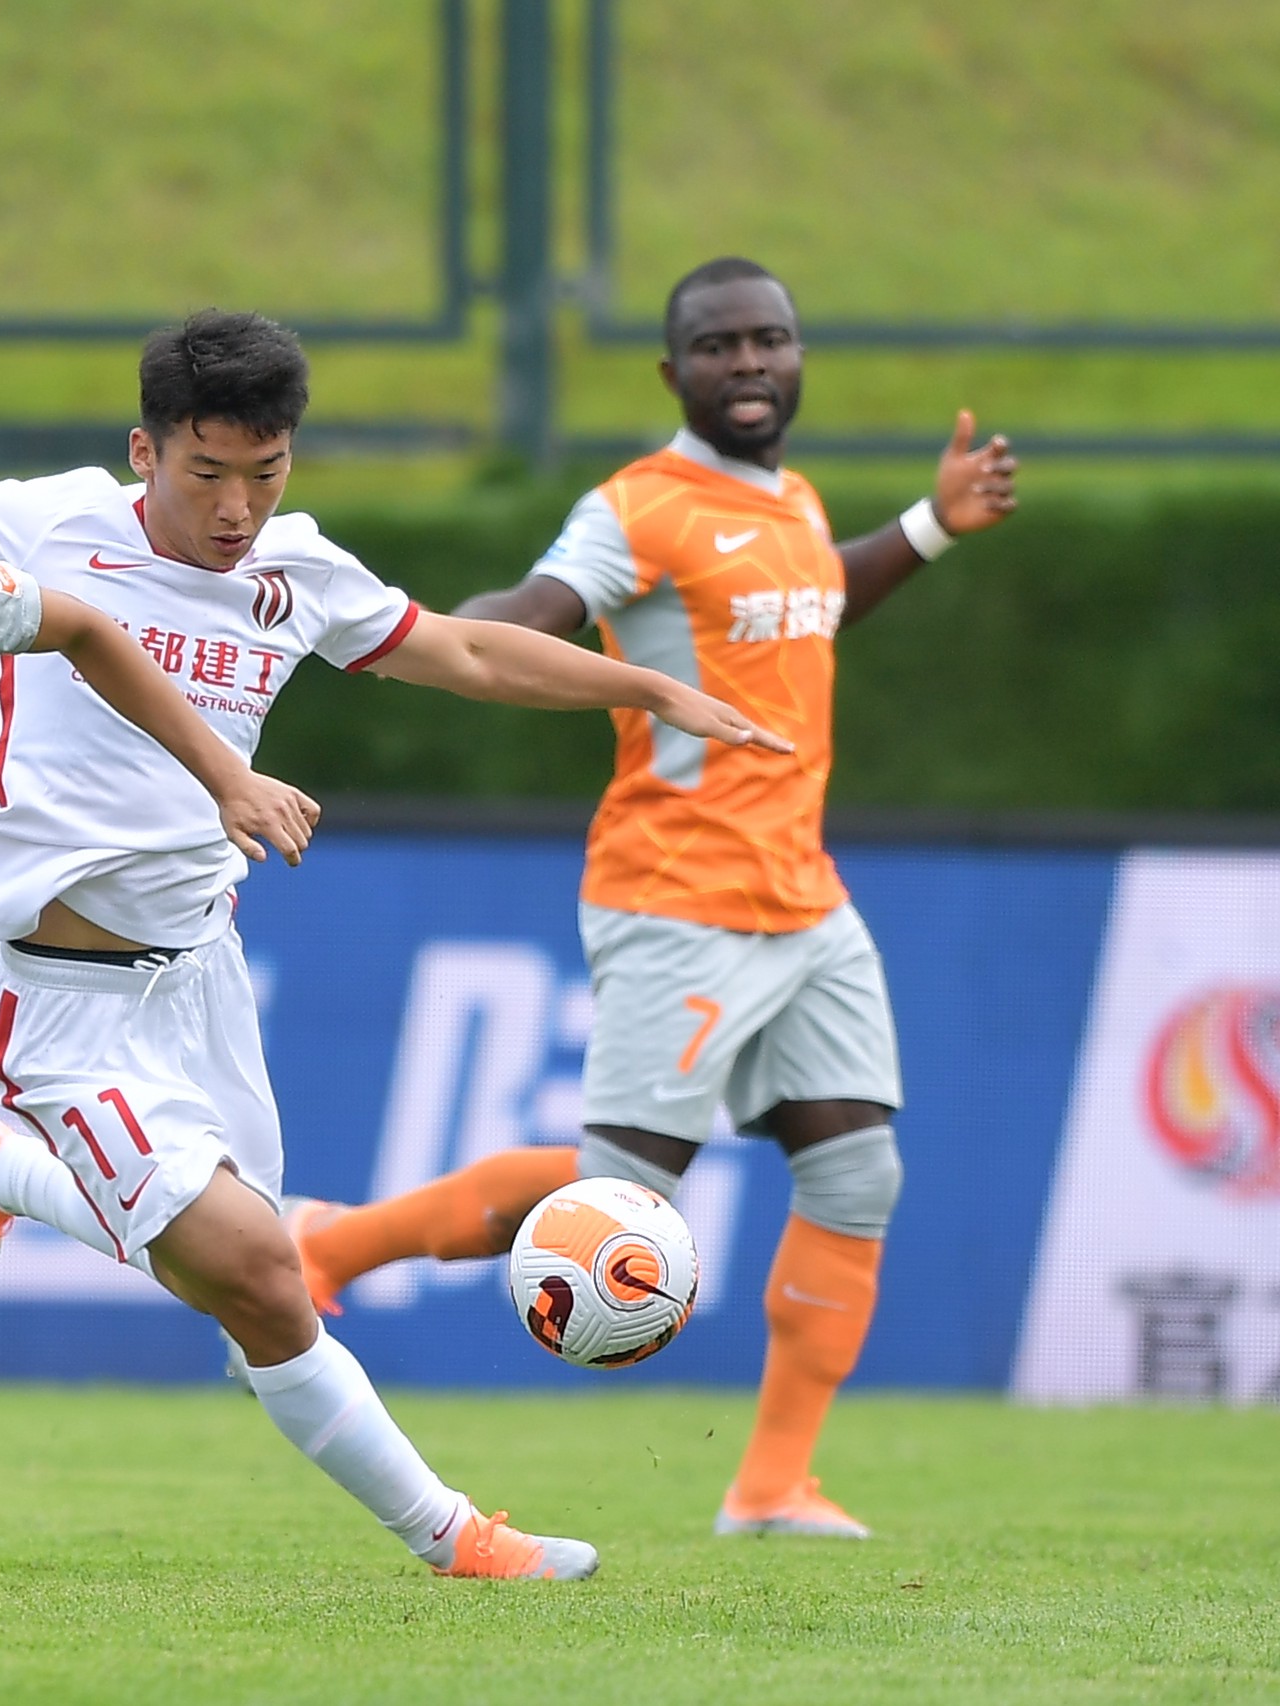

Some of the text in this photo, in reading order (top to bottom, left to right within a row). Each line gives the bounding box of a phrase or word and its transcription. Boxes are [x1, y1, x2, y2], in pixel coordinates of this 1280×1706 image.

[726, 588, 846, 643] 深投
[113, 618, 284, 696] 都建工
[183, 691, 266, 717] NSTRUCTIO
[684, 996, 721, 1074] 7
[62, 1087, 154, 1180] 11
